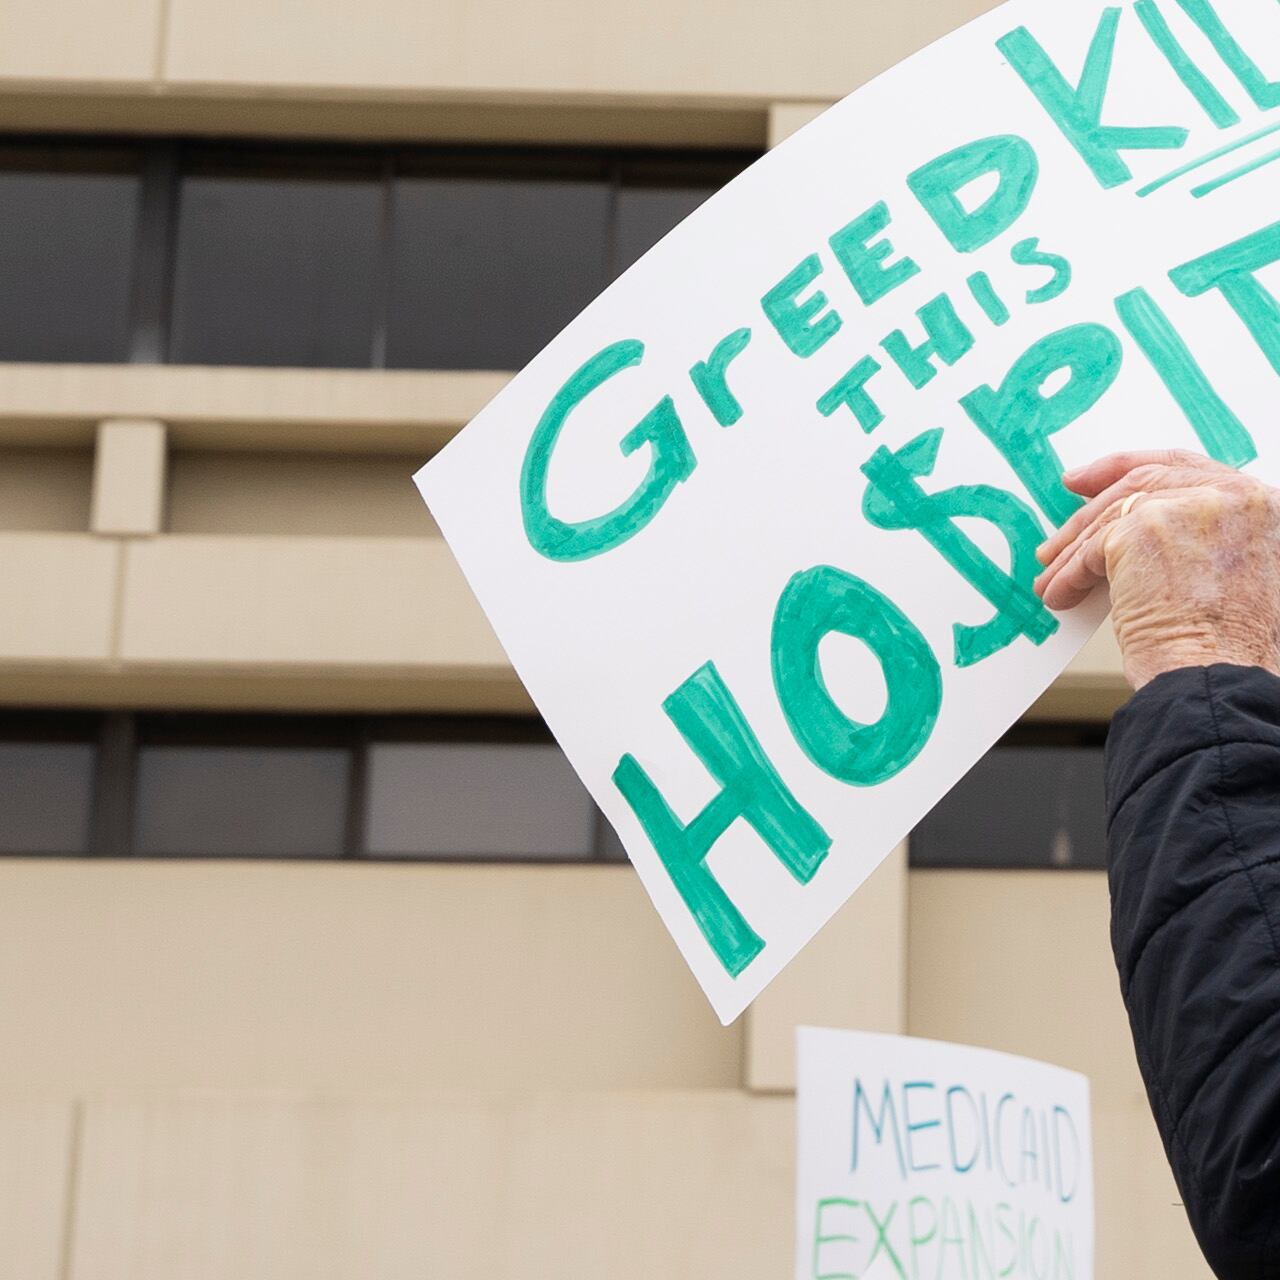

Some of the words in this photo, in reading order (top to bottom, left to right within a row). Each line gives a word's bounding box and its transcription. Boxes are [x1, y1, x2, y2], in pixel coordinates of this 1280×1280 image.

[816, 237, 1072, 434] THIS
[849, 1077, 1081, 1203] MEDICAID
[812, 1194, 1075, 1280] EXPANSION
